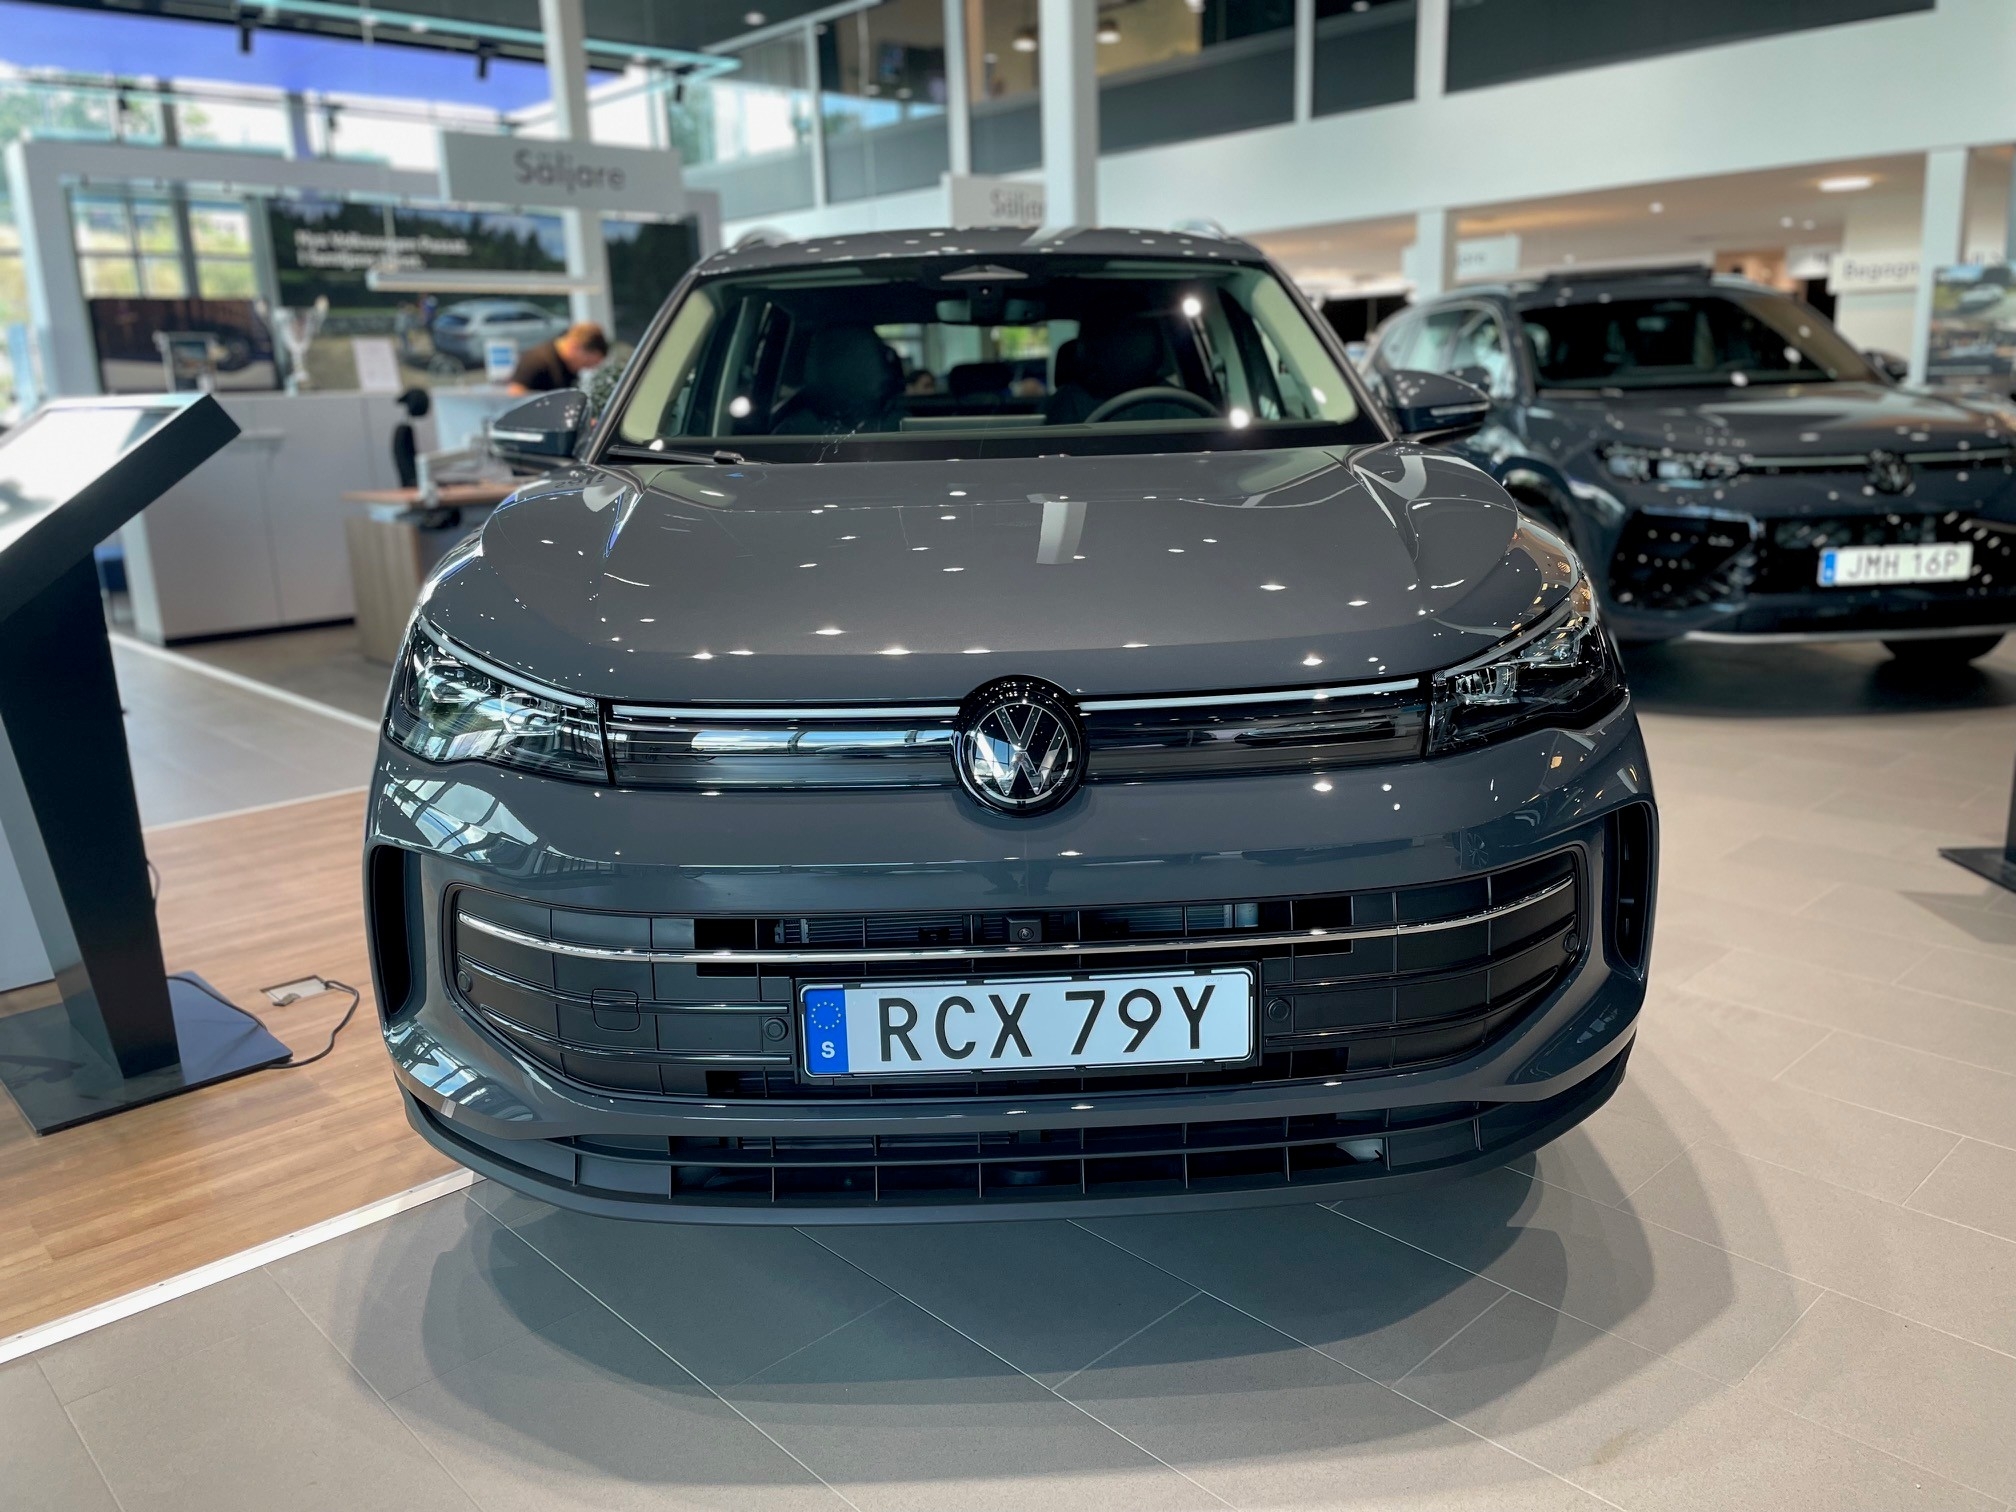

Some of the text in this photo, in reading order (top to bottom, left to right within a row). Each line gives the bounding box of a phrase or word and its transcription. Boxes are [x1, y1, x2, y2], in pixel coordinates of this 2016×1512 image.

[513, 149, 626, 195] Säljare
[1847, 553, 1900, 578] JMH
[1913, 549, 1960, 575] 16P
[878, 985, 1216, 1062] RCX 79Y
[821, 1041, 835, 1058] S
